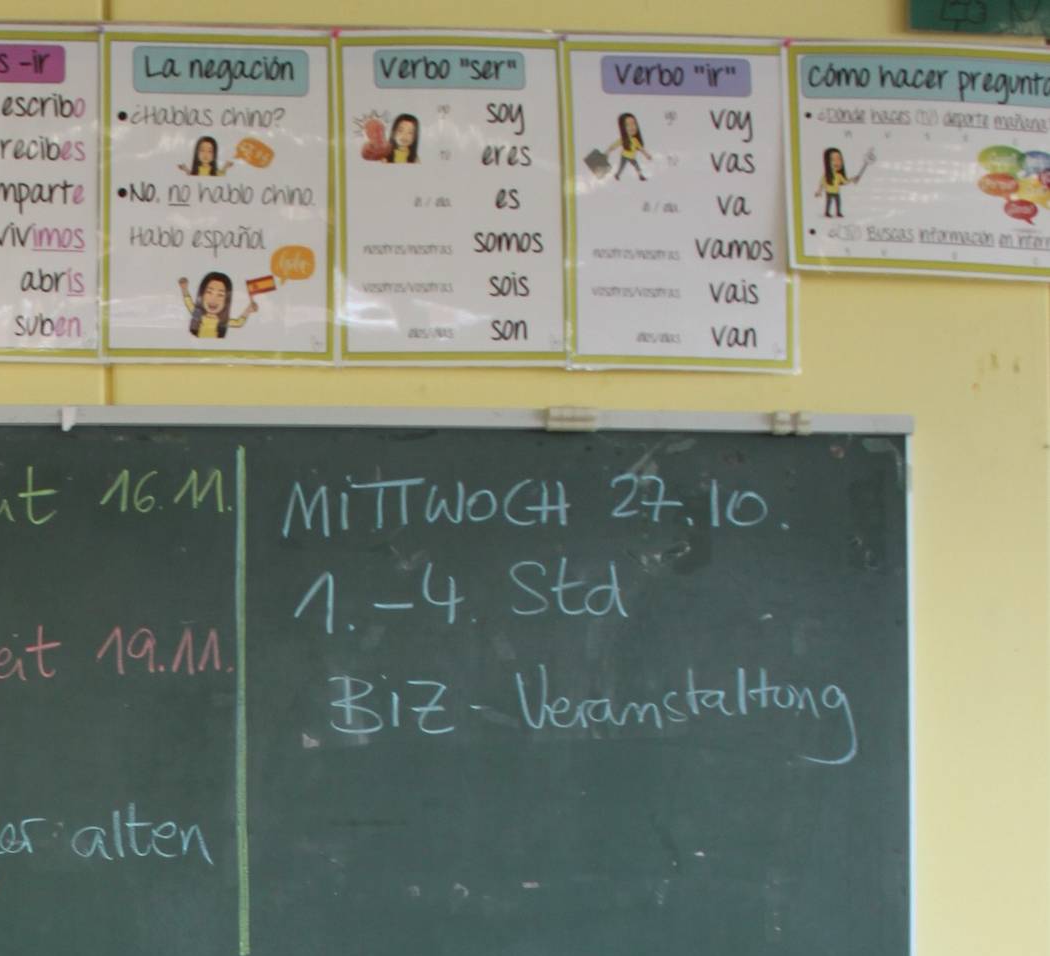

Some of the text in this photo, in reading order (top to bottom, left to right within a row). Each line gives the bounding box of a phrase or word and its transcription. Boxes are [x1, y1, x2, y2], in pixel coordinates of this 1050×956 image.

[18, 51, 51, 74] -ir
[145, 55, 294, 91] La negación
[380, 57, 517, 80] Verbo "ser"
[614, 64, 736, 87] Verbo "ir"
[879, 64, 949, 90] hacer
[1, 93, 86, 118] escribo
[130, 104, 286, 128] ¿Hablas chino?
[486, 102, 525, 136] soy
[709, 109, 753, 143] voy
[0, 136, 86, 161] recibes
[481, 145, 532, 167] eres
[710, 151, 756, 174] vas
[168, 184, 191, 203] no
[199, 182, 254, 204] hablo
[495, 188, 521, 210] es
[716, 195, 752, 217] va
[129, 226, 184, 248] Hablo
[474, 231, 545, 253] somos
[694, 237, 774, 262] vamos
[488, 272, 530, 297] sois
[709, 279, 760, 305] vais
[14, 312, 82, 337] suben
[491, 319, 528, 341] son
[711, 324, 758, 348] van
[610, 472, 790, 529] 27.10.
[509, 556, 628, 618] Std
[96, 626, 234, 676] 19.11.
[71, 801, 214, 866] alten
